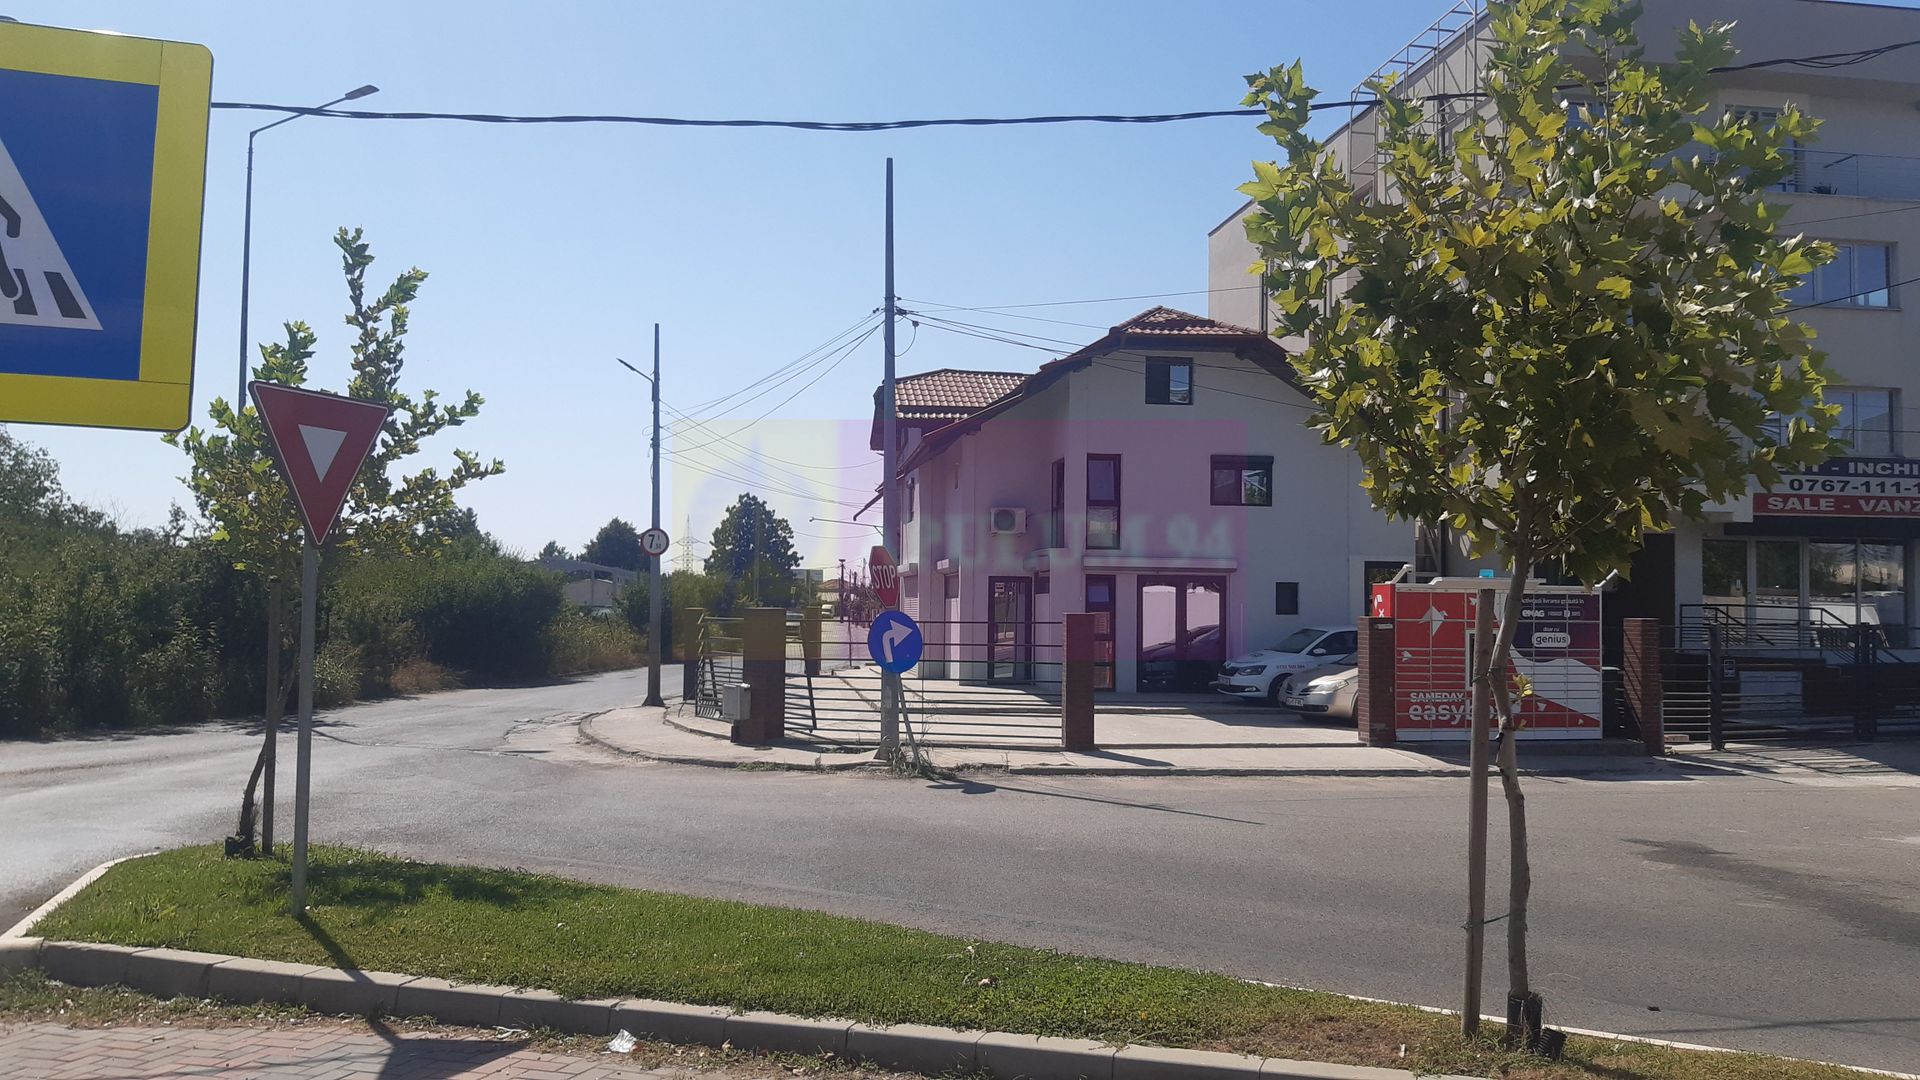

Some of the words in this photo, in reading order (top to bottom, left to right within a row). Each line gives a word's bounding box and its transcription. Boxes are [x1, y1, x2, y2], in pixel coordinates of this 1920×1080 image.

[1848, 461, 1919, 475] INCHI
[1767, 496, 1835, 511] SALE
[872, 564, 896, 589] STOP
[1535, 634, 1567, 645] genius
[1409, 692, 1465, 703] SAMEDAY
